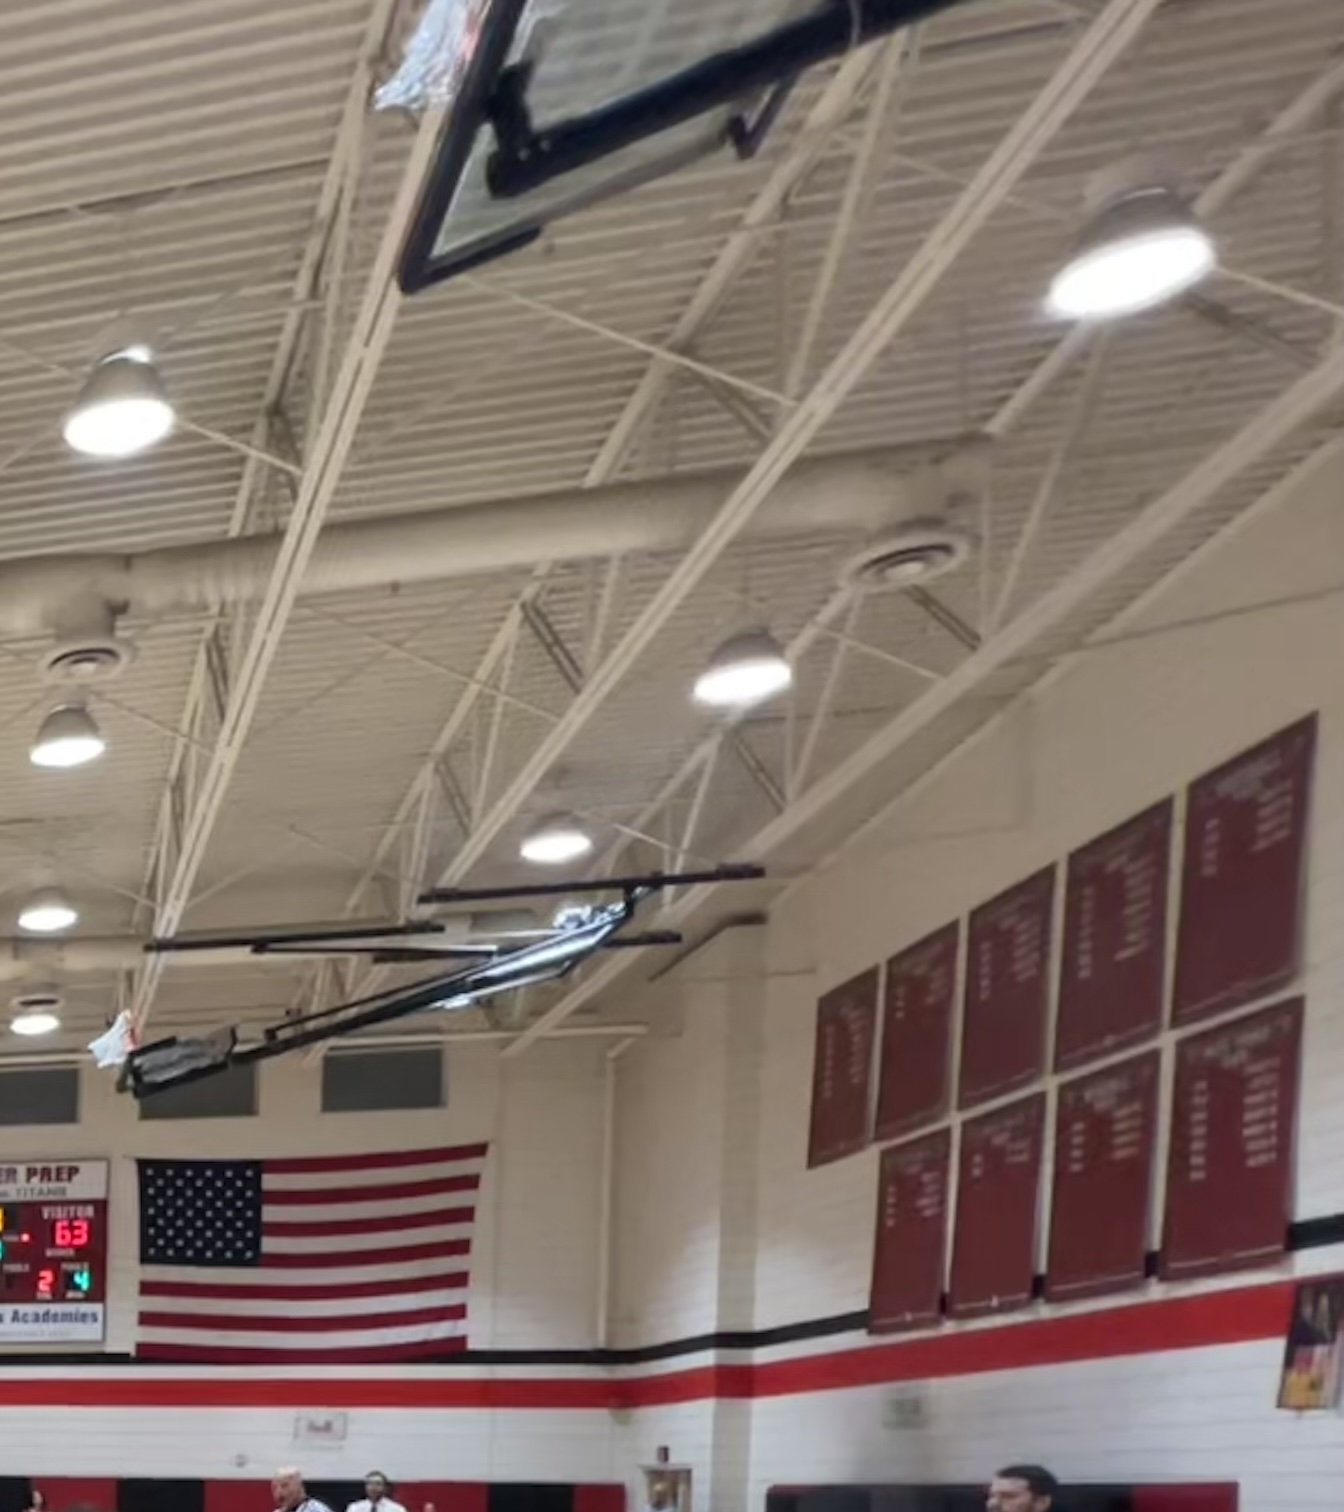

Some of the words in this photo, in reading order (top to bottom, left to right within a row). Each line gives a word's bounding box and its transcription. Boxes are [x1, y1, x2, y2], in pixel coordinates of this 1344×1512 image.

[26, 1165, 80, 1184] PREP
[41, 1205, 95, 1221] VISITOR
[55, 1220, 89, 1247] 63
[38, 1269, 54, 1292] 2
[73, 1270, 90, 1292] 4
[11, 1307, 99, 1324] Academies
